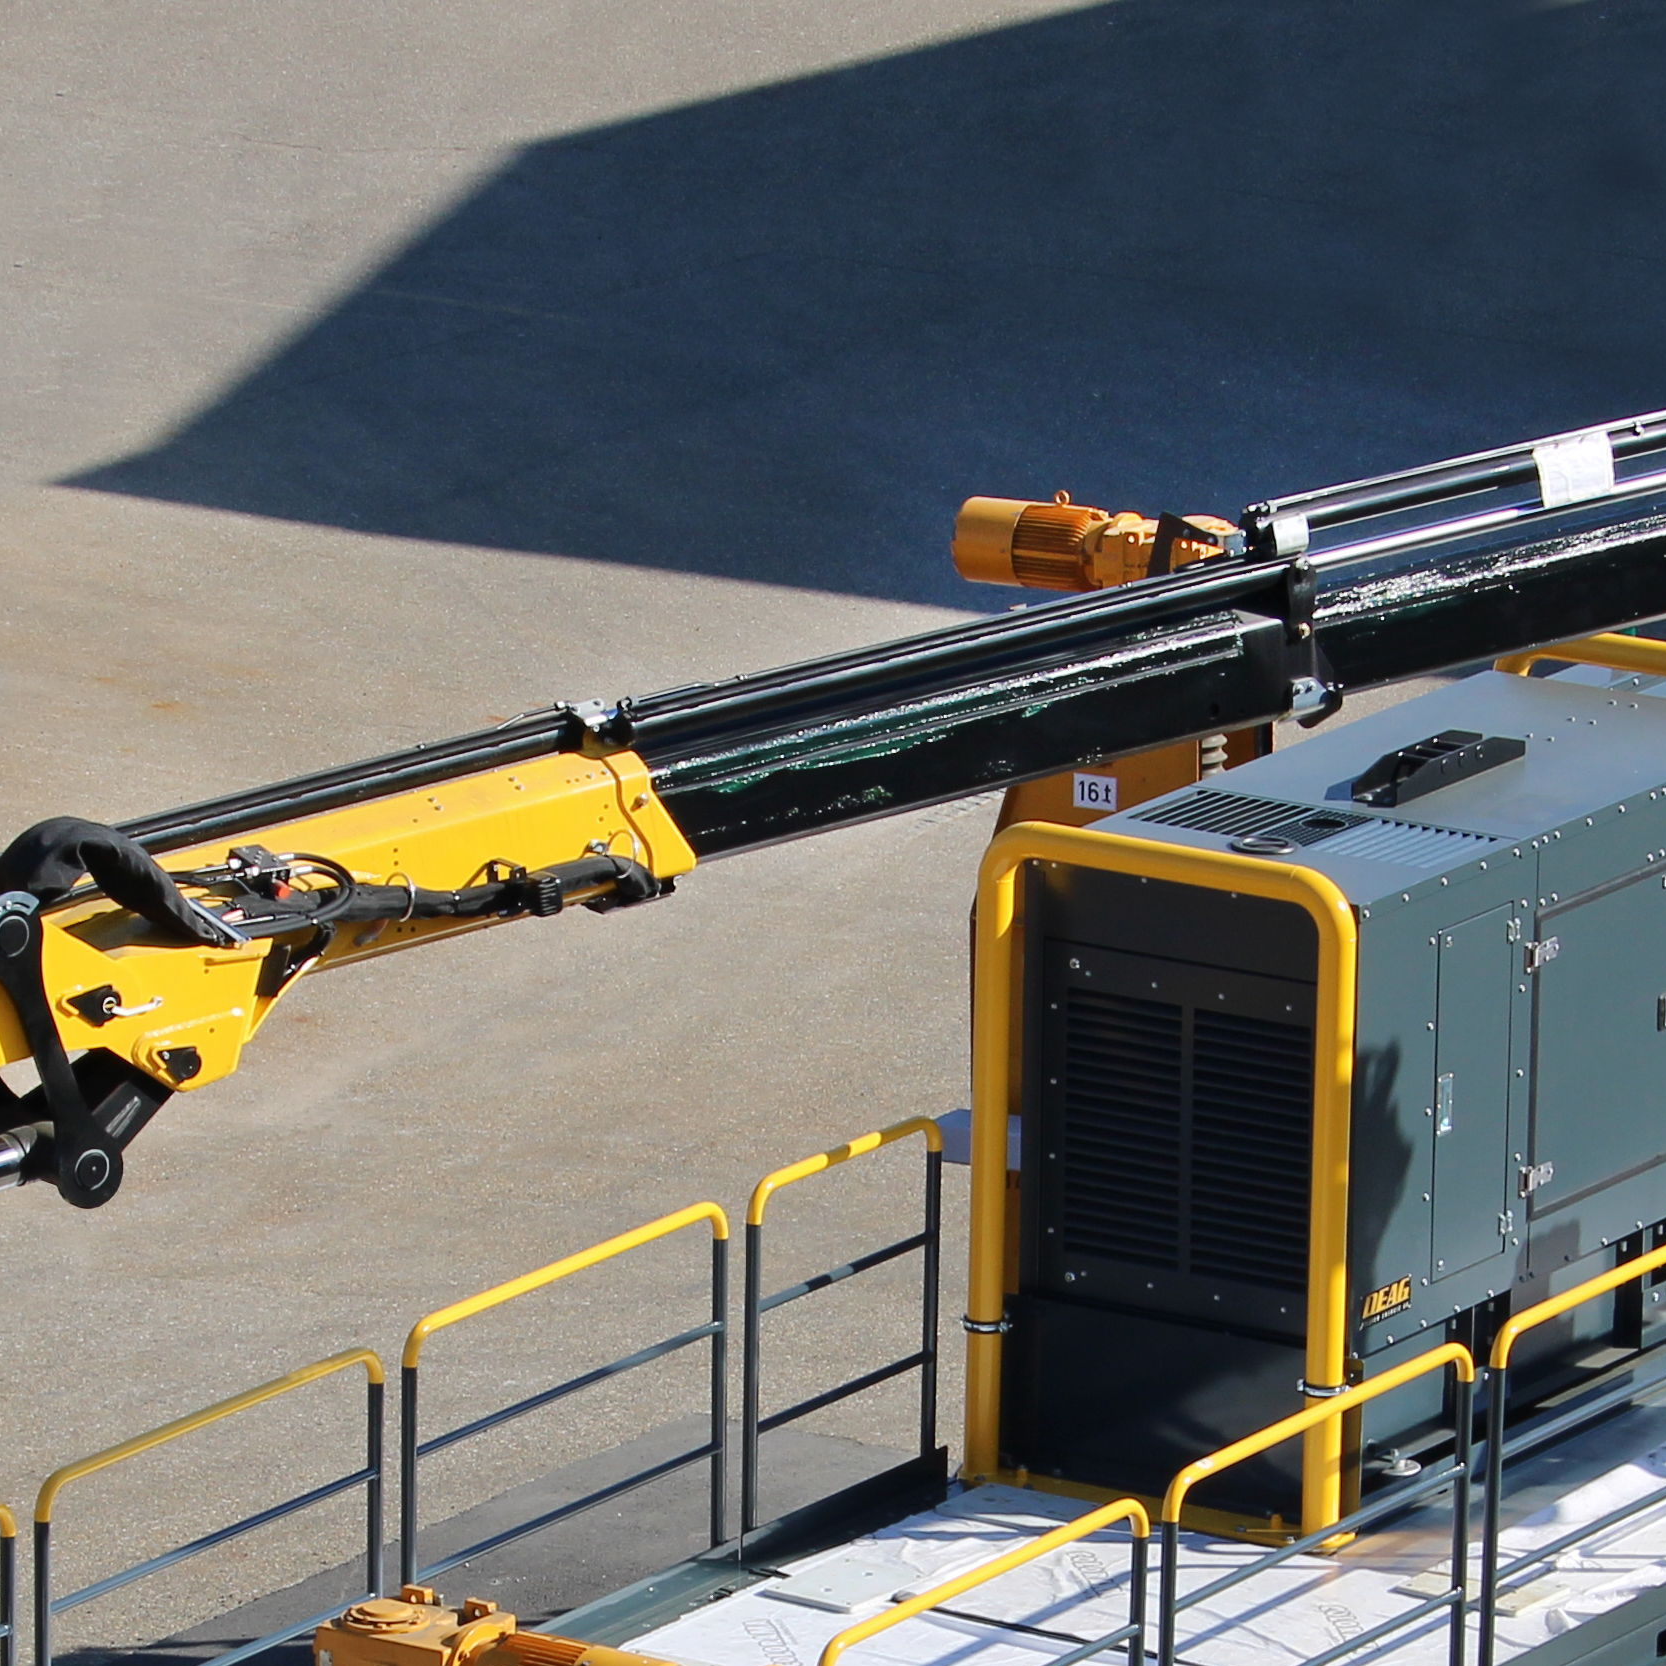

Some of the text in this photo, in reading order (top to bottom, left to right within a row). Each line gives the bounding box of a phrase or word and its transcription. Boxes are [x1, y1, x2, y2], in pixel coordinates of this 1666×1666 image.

[1078, 780, 1112, 804] 16 t
[1362, 1277, 1411, 1320] DEAG
